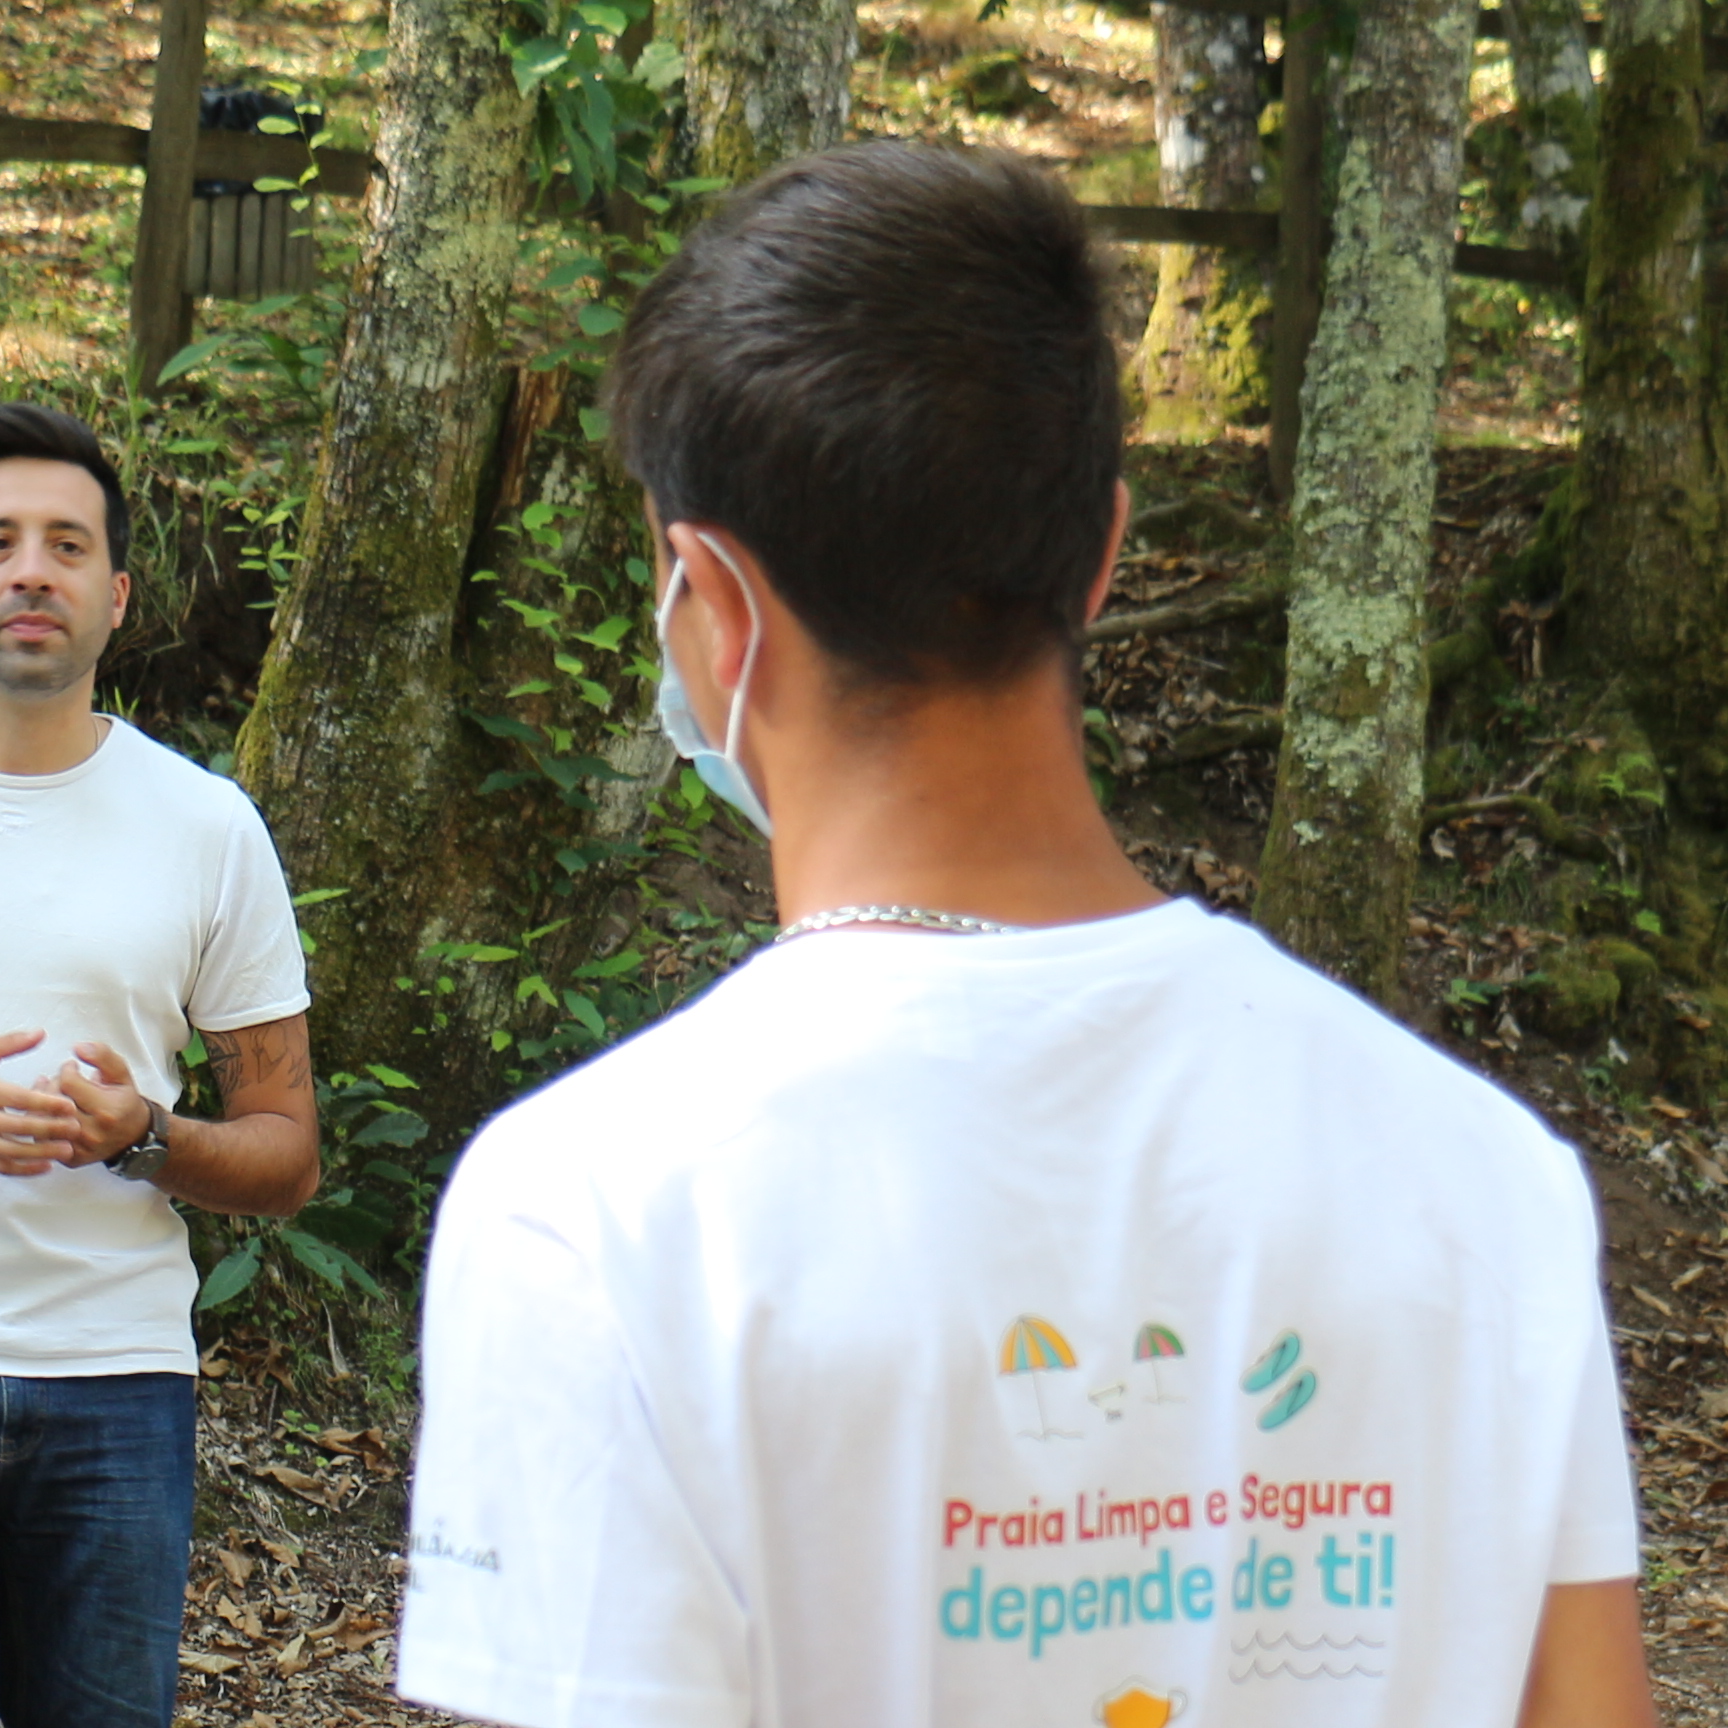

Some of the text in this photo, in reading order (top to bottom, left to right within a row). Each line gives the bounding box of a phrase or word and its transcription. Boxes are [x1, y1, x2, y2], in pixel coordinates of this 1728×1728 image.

[943, 1473, 1393, 1548] Praia Limpa e Segura
[939, 1533, 1397, 1659] depende de ti!
